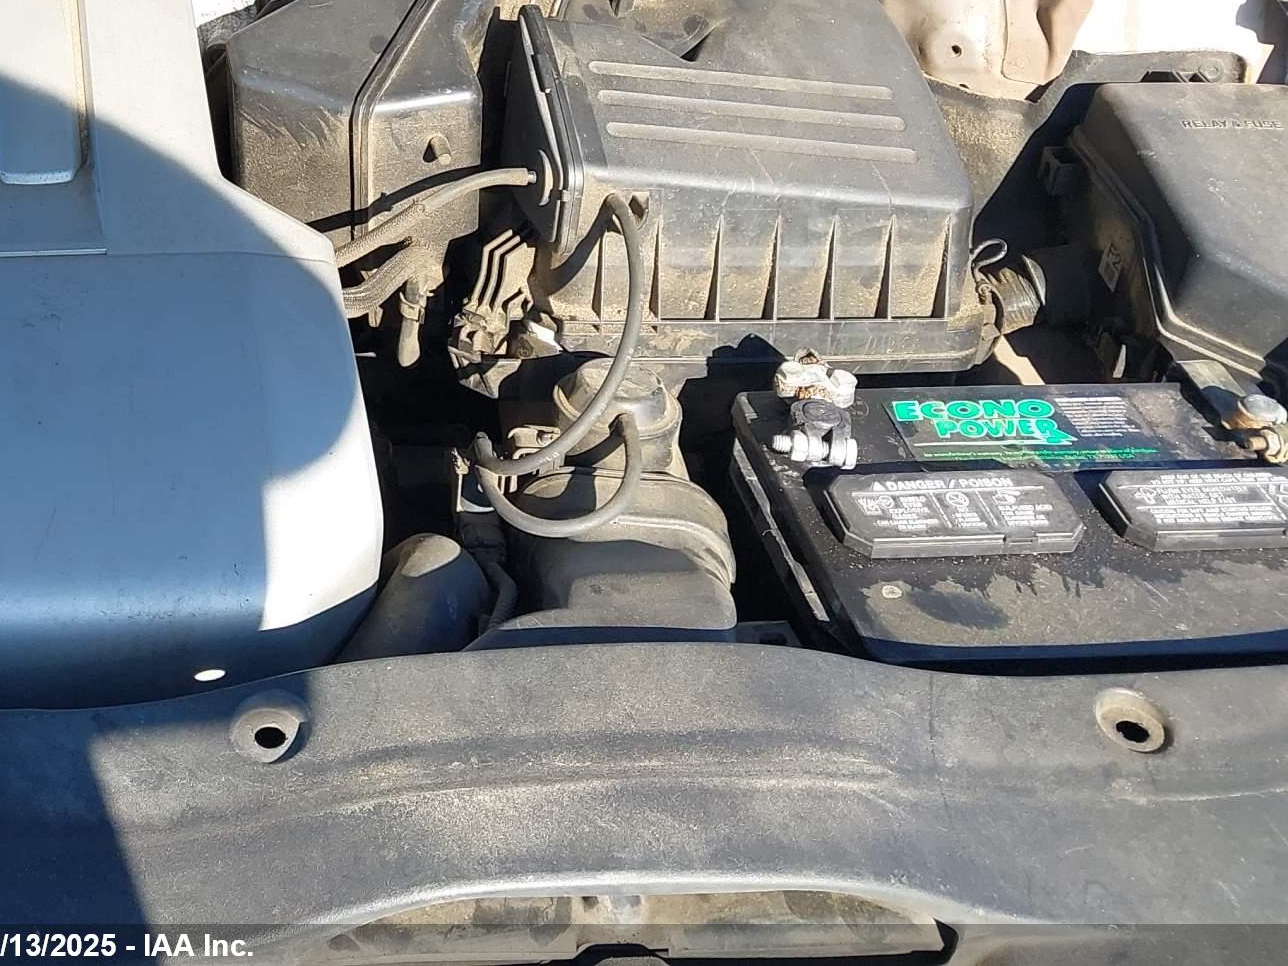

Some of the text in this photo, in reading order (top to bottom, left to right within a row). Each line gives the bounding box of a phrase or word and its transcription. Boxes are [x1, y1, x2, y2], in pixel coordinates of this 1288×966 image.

[1180, 120, 1228, 130] RELAY
[1243, 120, 1283, 131] FUSE
[892, 399, 1053, 421] ECONO
[934, 418, 1072, 443] POWER
[885, 480, 946, 491] DANGER
[959, 478, 1013, 488] POISON
